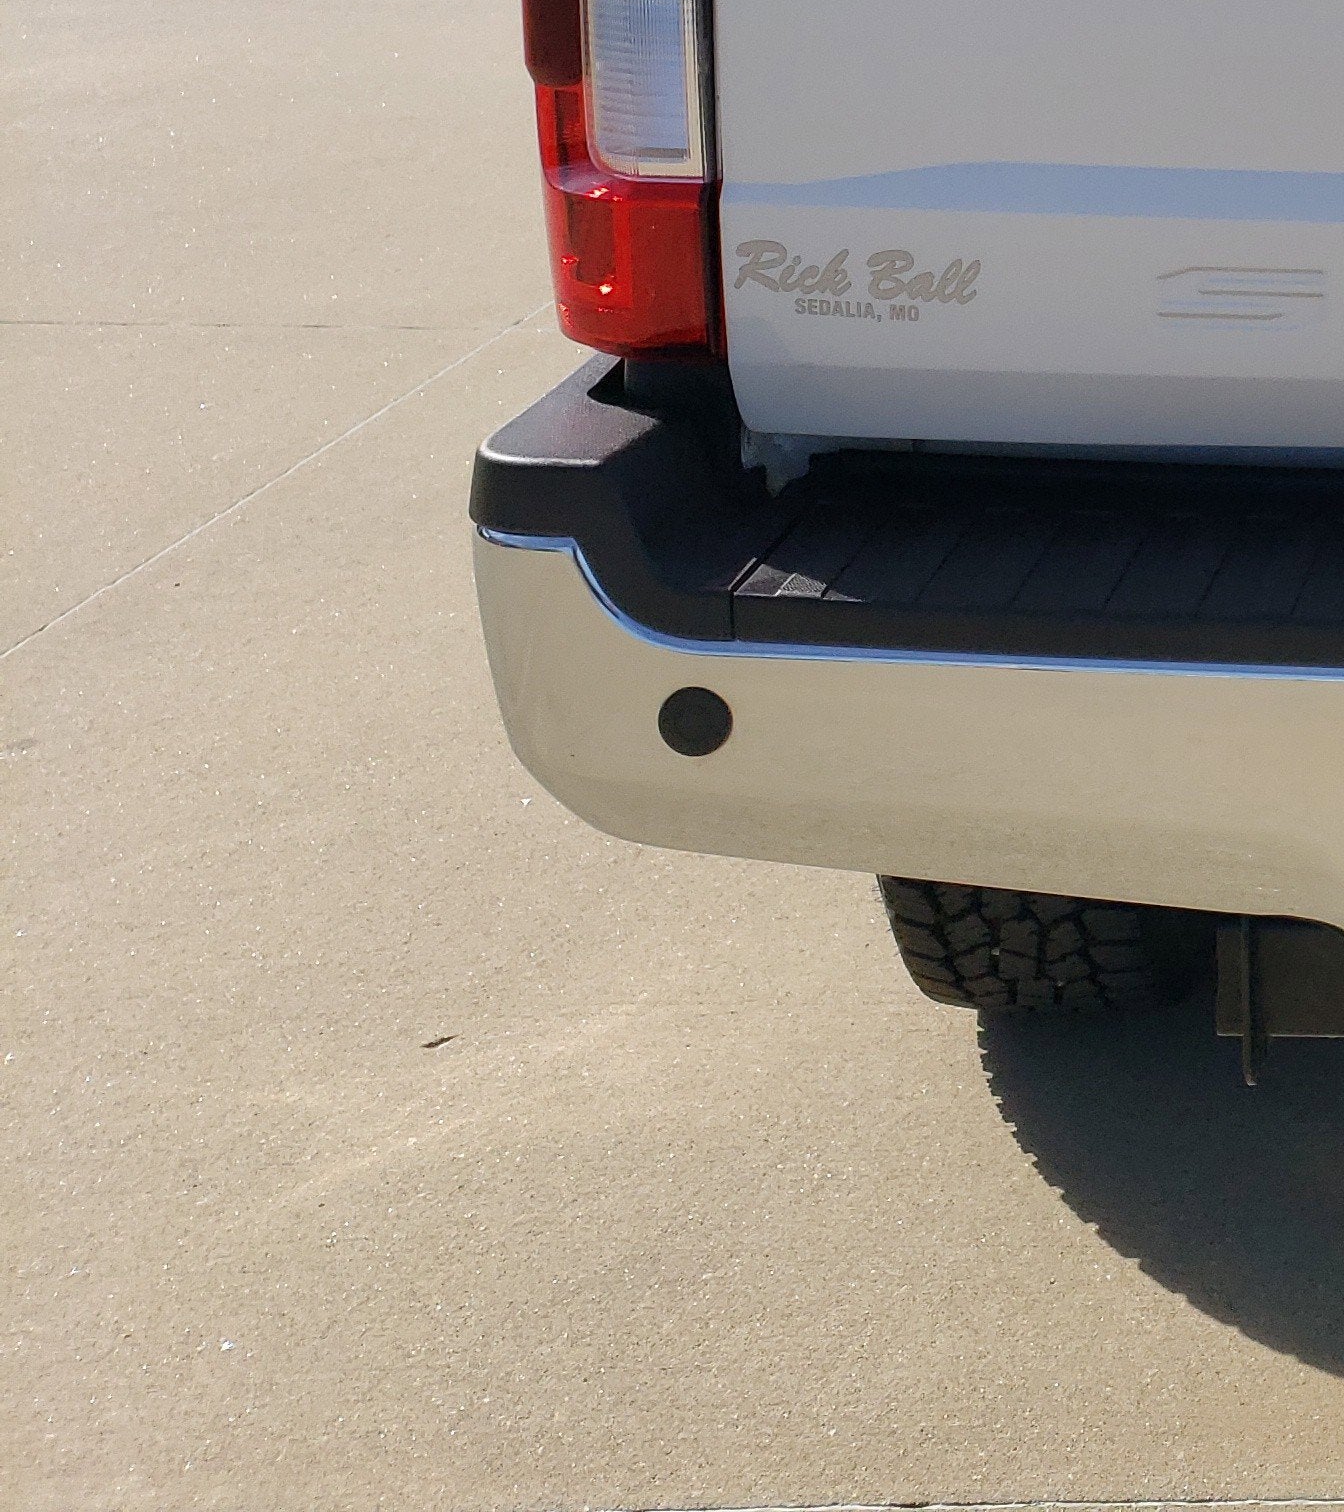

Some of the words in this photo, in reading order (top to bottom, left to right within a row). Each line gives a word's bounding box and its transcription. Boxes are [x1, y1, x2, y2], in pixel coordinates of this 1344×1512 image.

[734, 239, 851, 296] Rick
[866, 249, 982, 305] Ball
[794, 298, 882, 323] SEDALIA,
[889, 304, 920, 322] MO
